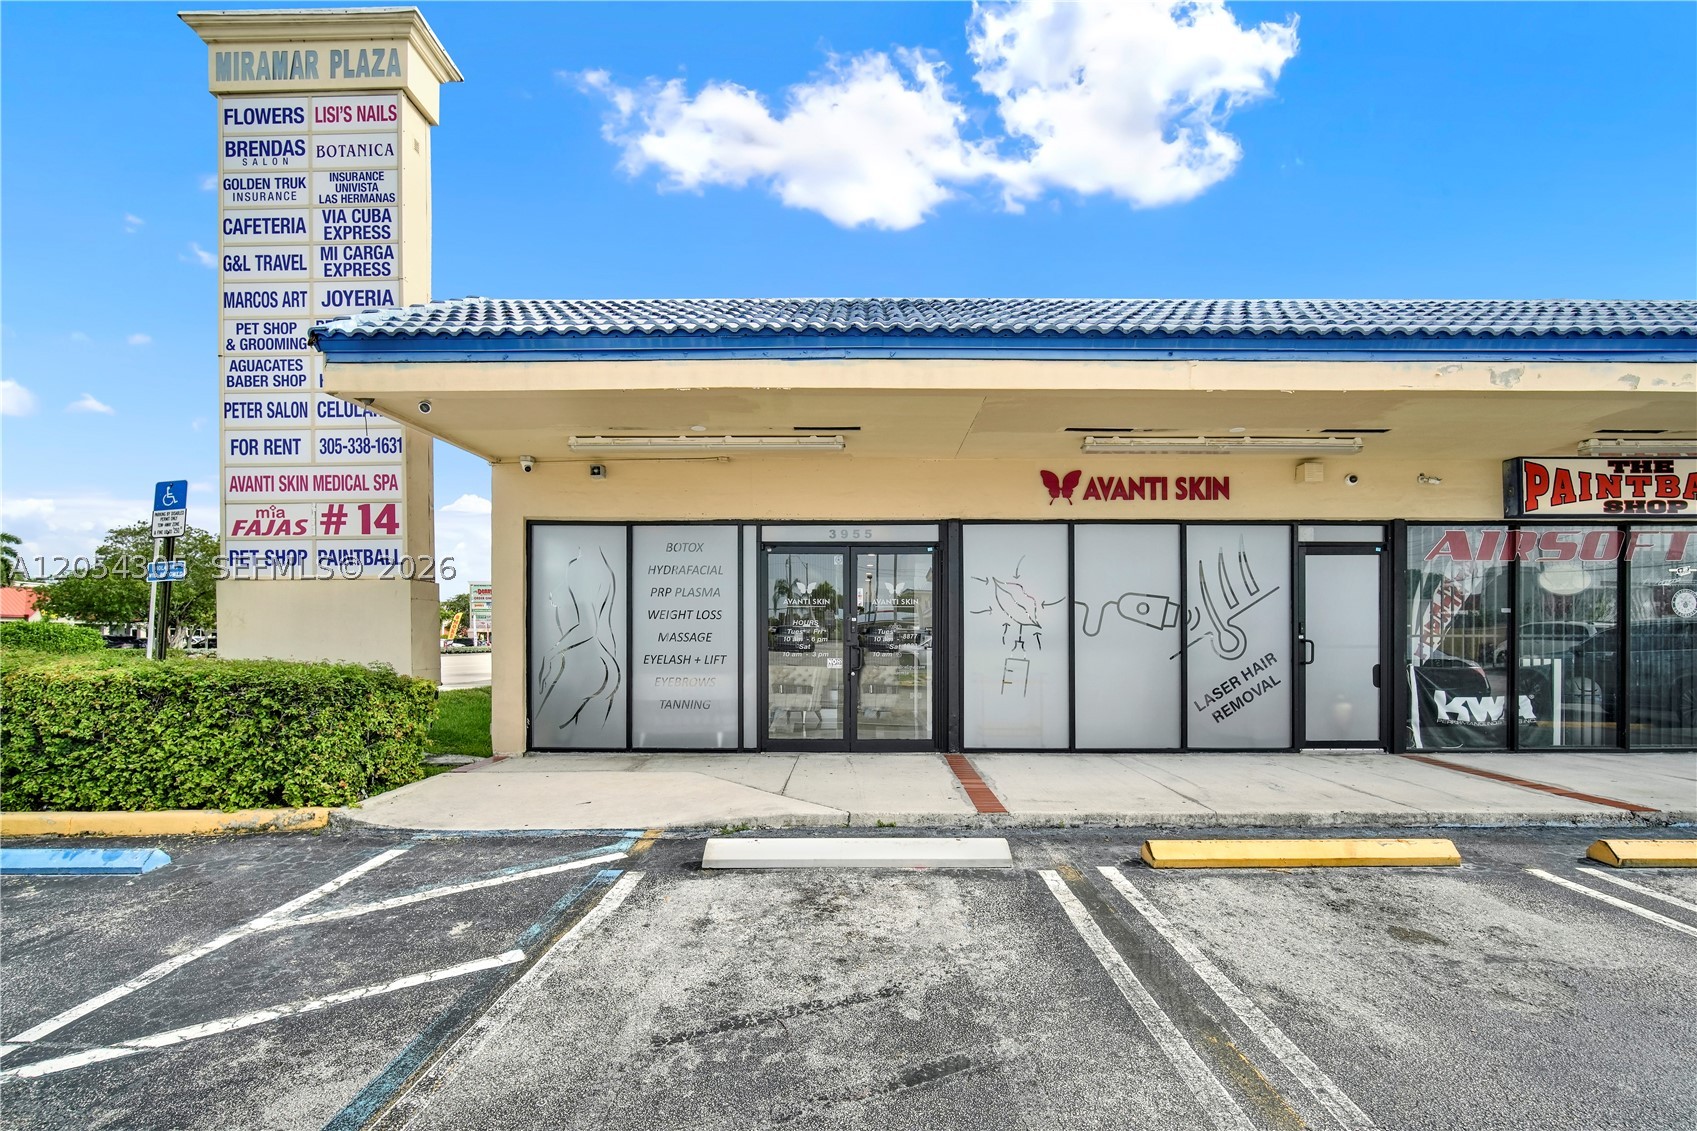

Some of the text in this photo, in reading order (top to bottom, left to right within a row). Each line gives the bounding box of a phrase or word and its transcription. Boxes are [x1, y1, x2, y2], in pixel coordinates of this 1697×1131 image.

[215, 48, 402, 82] MIRAMAR PLAZA
[223, 106, 305, 126] FLOWERS
[314, 104, 397, 123] LISI'S NAILS
[225, 139, 306, 158] BRENDAS
[316, 143, 395, 158] BOTANICA
[242, 157, 289, 167] SALON
[223, 177, 307, 191] GOLDEN TRUK
[329, 171, 385, 182] INSURANCE
[335, 182, 379, 193] UNIVISTA
[232, 191, 297, 202] INSURANCE
[318, 192, 396, 204] LAS HERMANAS
[322, 208, 392, 224] VIA CUBA
[223, 217, 307, 236] CAFETERIA
[323, 225, 391, 241] EXPRESS
[320, 245, 394, 261] MI CARGA
[223, 254, 307, 272] G&L TRAVEL
[323, 262, 391, 278] EXPRESS
[223, 290, 307, 309] MARCOS ART
[321, 289, 394, 307] JOYERIA
[236, 322, 297, 335] PET SHOP
[226, 337, 307, 351] & GROOMING
[229, 359, 304, 372] AGUACATES
[226, 375, 269, 388] BABER
[272, 374, 307, 387] SHOP
[224, 401, 308, 419] PETER SALON
[317, 401, 384, 418] CELULA
[230, 438, 301, 456] FOR RENT
[319, 437, 403, 455] 305-338-1631
[1607, 460, 1675, 474] THE
[229, 474, 399, 493] AVANTI SKIN MEDICAL SPA
[1083, 476, 1230, 501] AVANTI SKIN
[256, 505, 285, 519] mia
[1603, 500, 1689, 514] SHOP
[320, 503, 400, 535] # 14
[231, 519, 308, 536] FAJAS
[829, 529, 873, 539] 3955
[666, 542, 704, 553] BOTOX
[1424, 529, 1697, 562] AIRSOFT
[229, 550, 308, 566] PET SHOP
[318, 549, 403, 566] PAINTBALL
[647, 565, 724, 575] HYDRAFACIAL
[650, 587, 721, 597] PRP PLASMA
[648, 610, 723, 620] WEIGHT LOSS
[792, 619, 819, 627] HOURS
[657, 632, 713, 643] MASSAGE
[643, 654, 692, 665] EYELASH
[704, 654, 728, 665] LIFT
[654, 677, 716, 687] EYEBROWS
[1194, 651, 1279, 713] LASER HAIR
[659, 699, 711, 710] TANNING
[1211, 675, 1282, 724] REMOVAL
